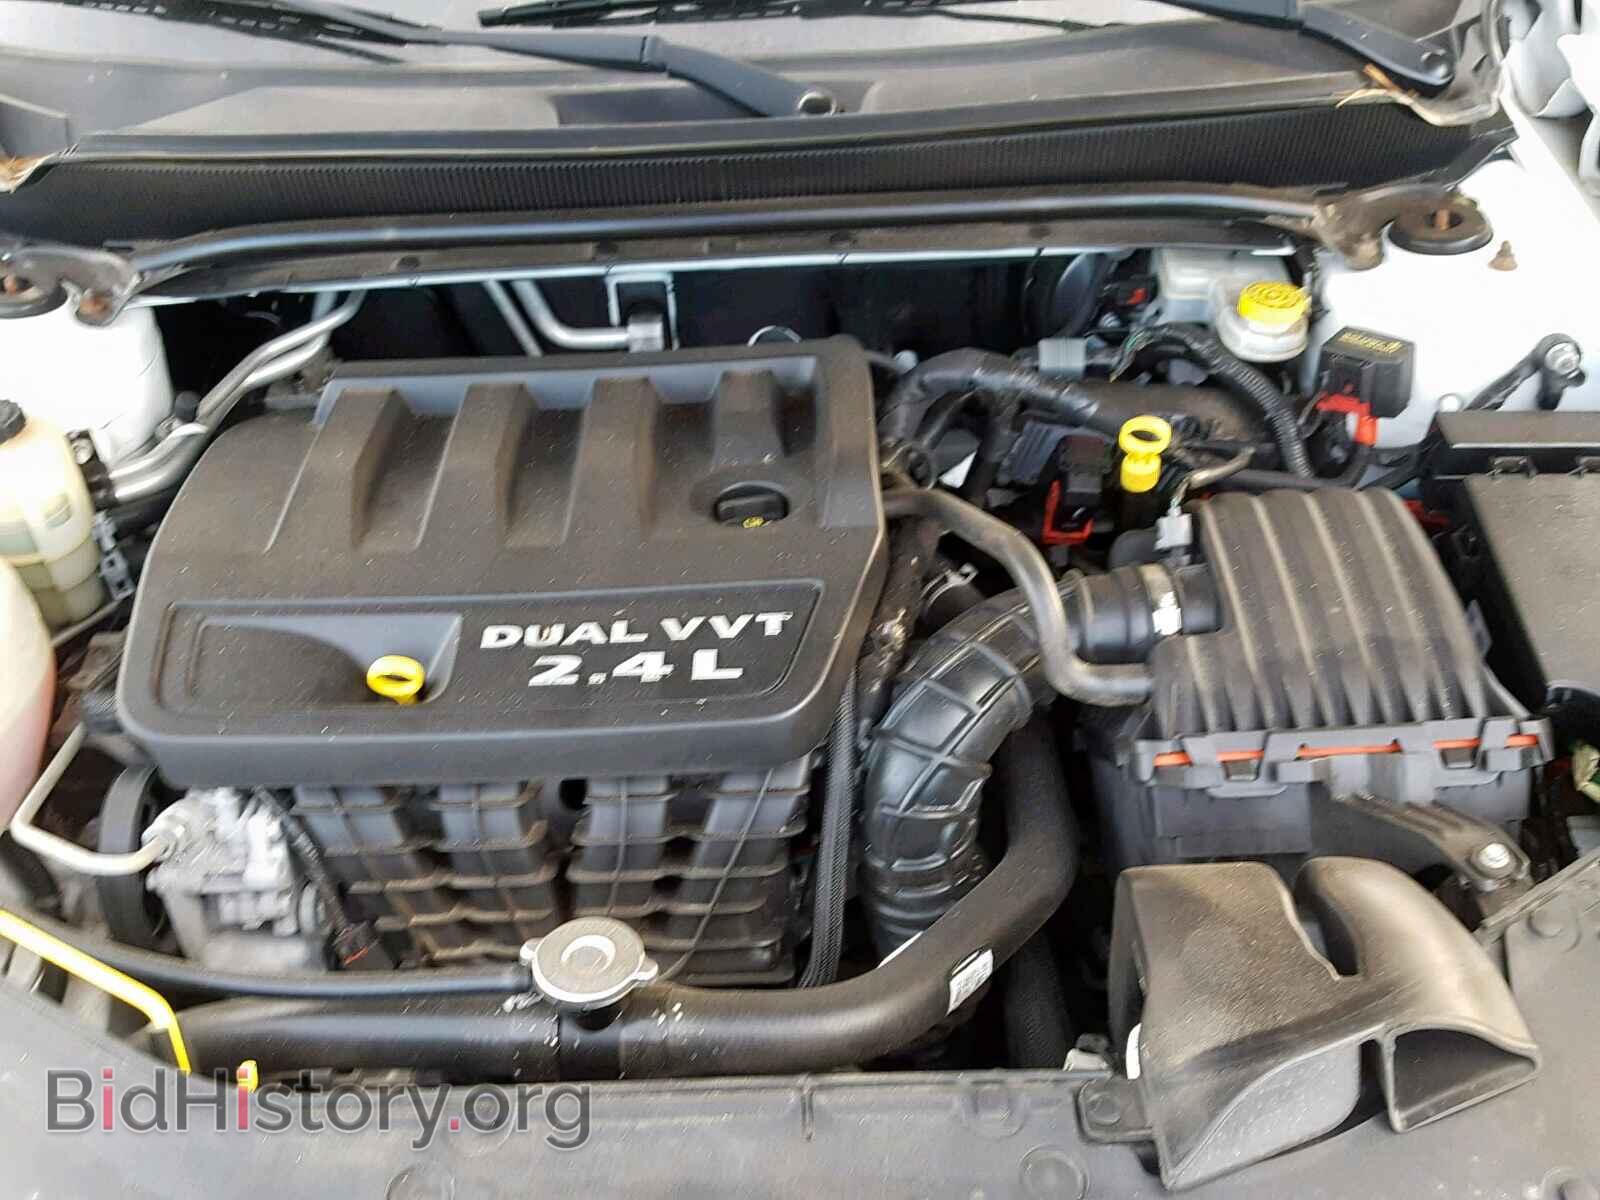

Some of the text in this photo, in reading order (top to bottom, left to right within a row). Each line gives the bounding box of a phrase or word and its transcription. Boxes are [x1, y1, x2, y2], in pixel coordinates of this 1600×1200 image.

[480, 611, 794, 649] DUAL VVT
[528, 648, 744, 687] 2.4 L
